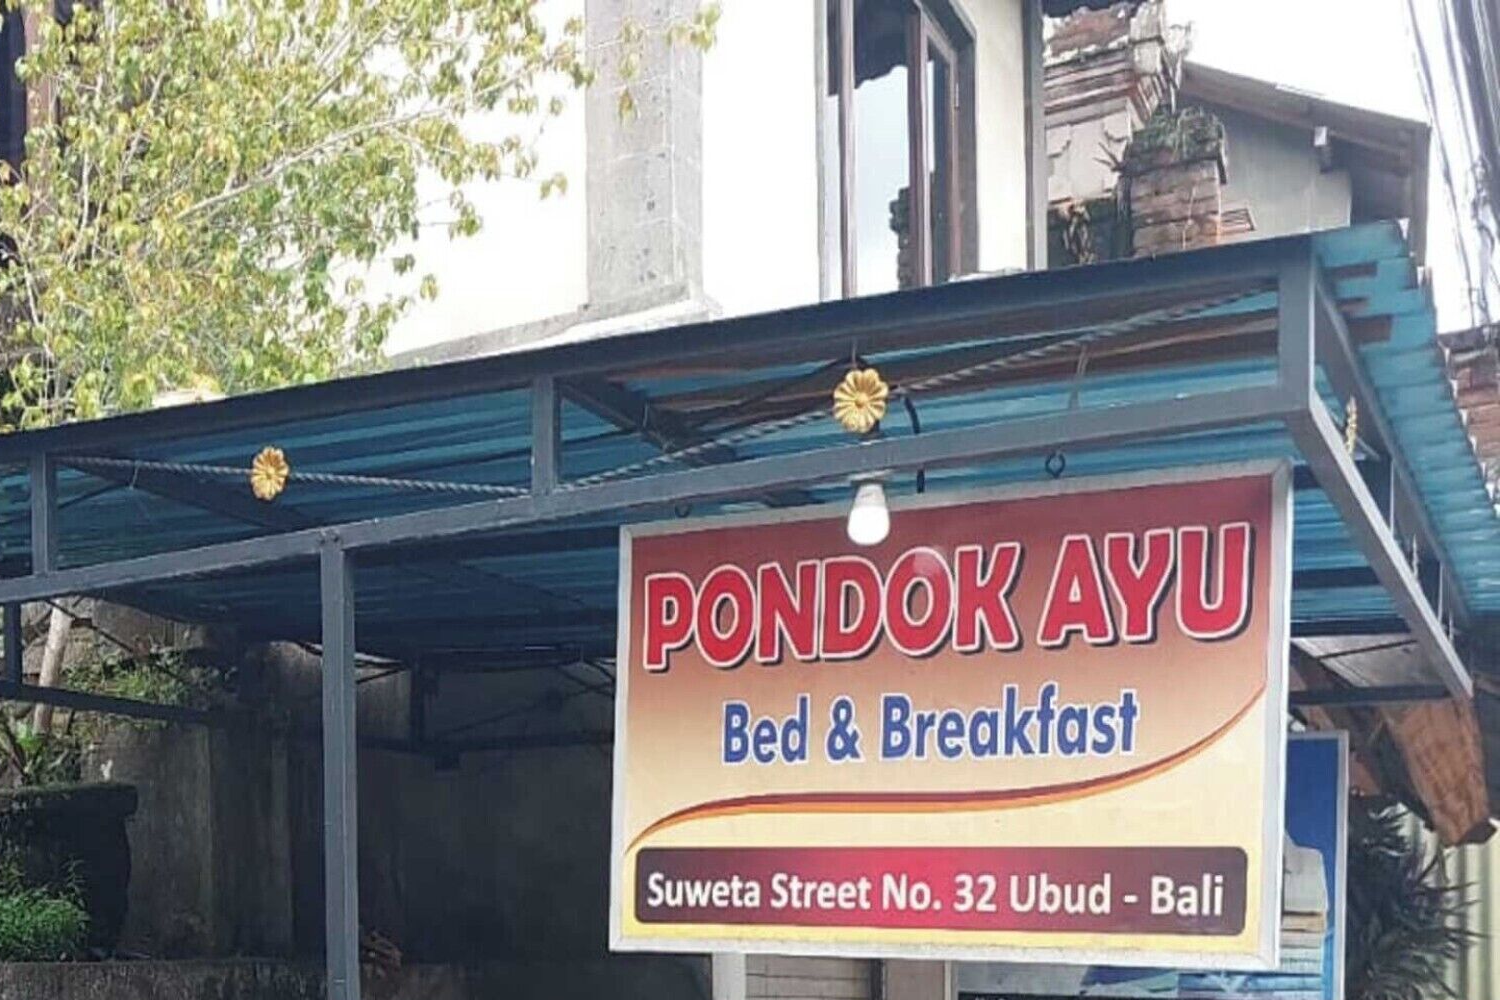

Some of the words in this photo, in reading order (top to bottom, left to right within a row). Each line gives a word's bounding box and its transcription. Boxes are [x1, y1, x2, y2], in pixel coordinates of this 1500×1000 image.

[642, 541, 1022, 672] PONDOK
[1037, 522, 1252, 648] AYU
[721, 692, 810, 765] Bed
[825, 697, 861, 762] &
[880, 683, 1139, 761] Breakfast
[646, 872, 761, 908] Suweta
[770, 872, 871, 911] Street
[882, 874, 942, 911] No.
[953, 874, 997, 913] 32
[1008, 873, 1111, 915] Ubud
[1150, 874, 1224, 916] Bali
